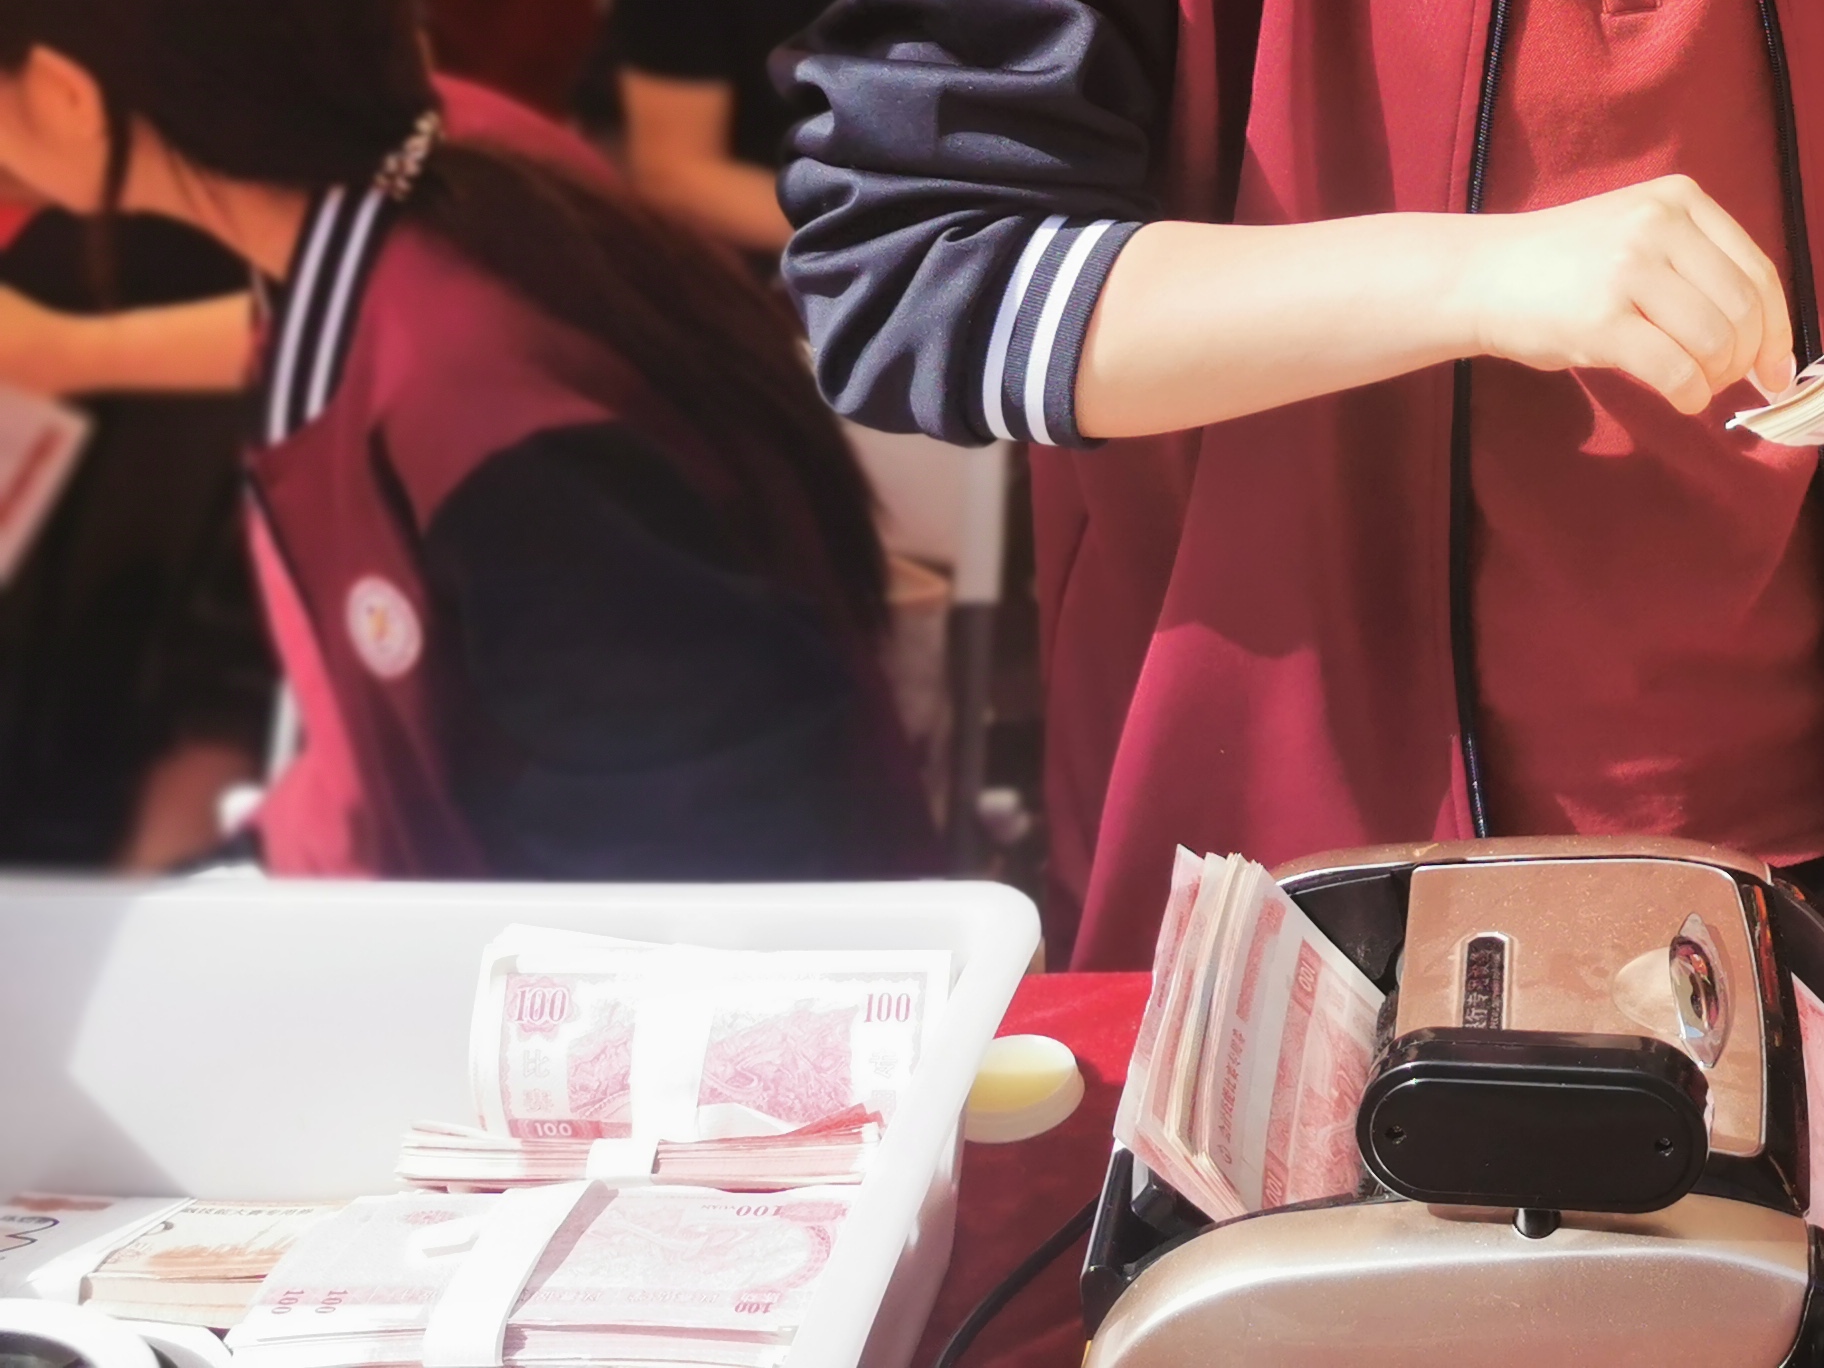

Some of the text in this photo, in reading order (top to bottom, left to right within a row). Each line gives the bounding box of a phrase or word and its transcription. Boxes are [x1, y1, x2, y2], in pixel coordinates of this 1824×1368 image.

[515, 986, 569, 1024] 100
[863, 992, 912, 1024] 100
[535, 1122, 572, 1138] 100
[271, 1288, 305, 1315] 100
[315, 1288, 349, 1315] 100
